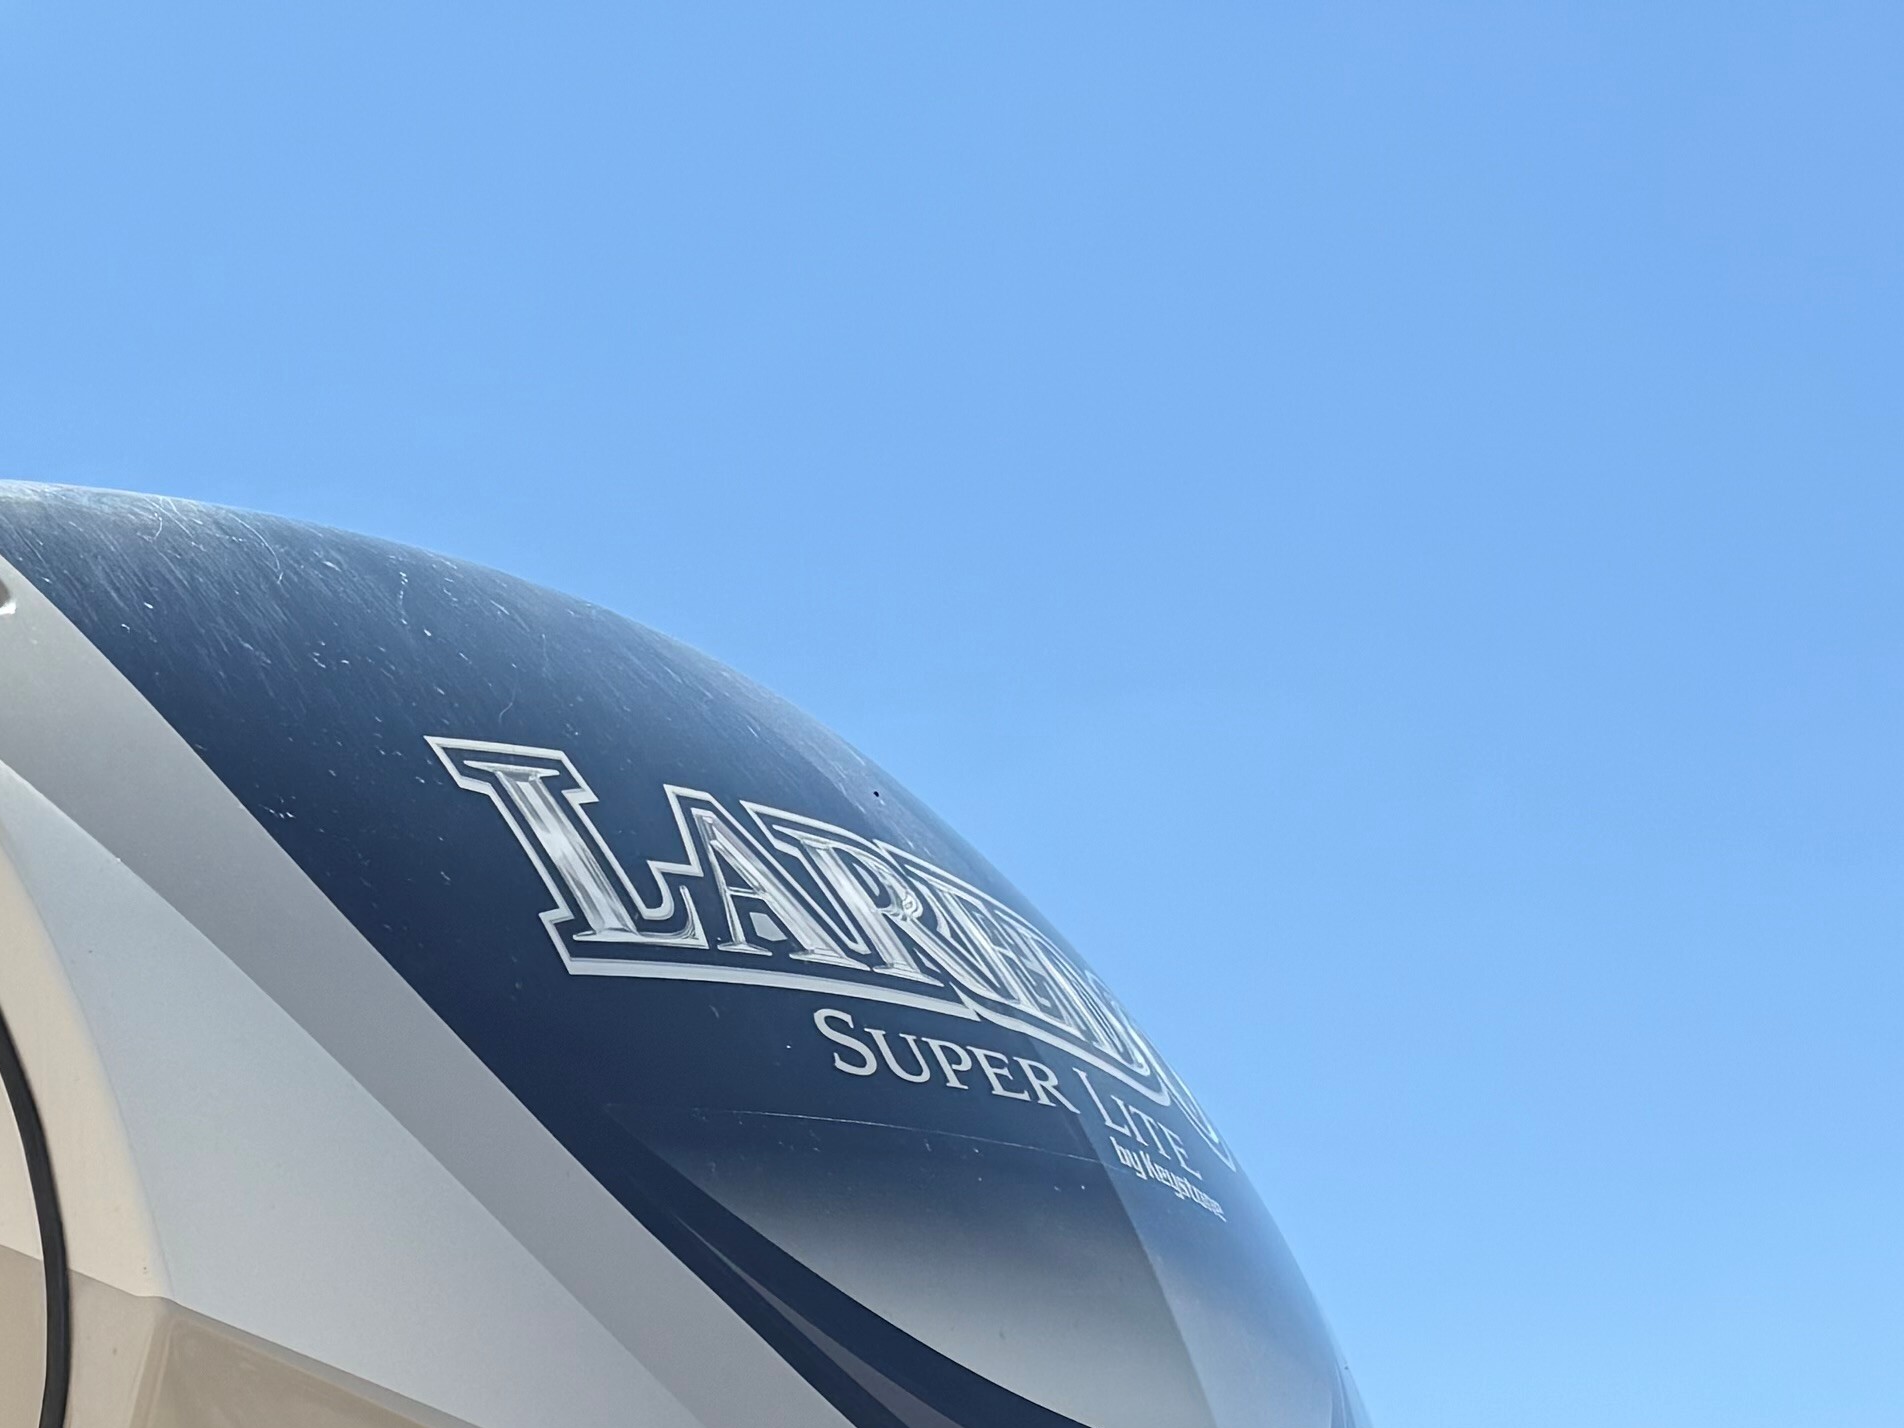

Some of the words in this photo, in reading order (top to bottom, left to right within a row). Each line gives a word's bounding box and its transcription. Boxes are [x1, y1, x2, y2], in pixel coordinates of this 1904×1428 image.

[813, 1008, 1081, 1115] SUPER
[1072, 1065, 1203, 1181] LITE
[1109, 1135, 1149, 1181] by
